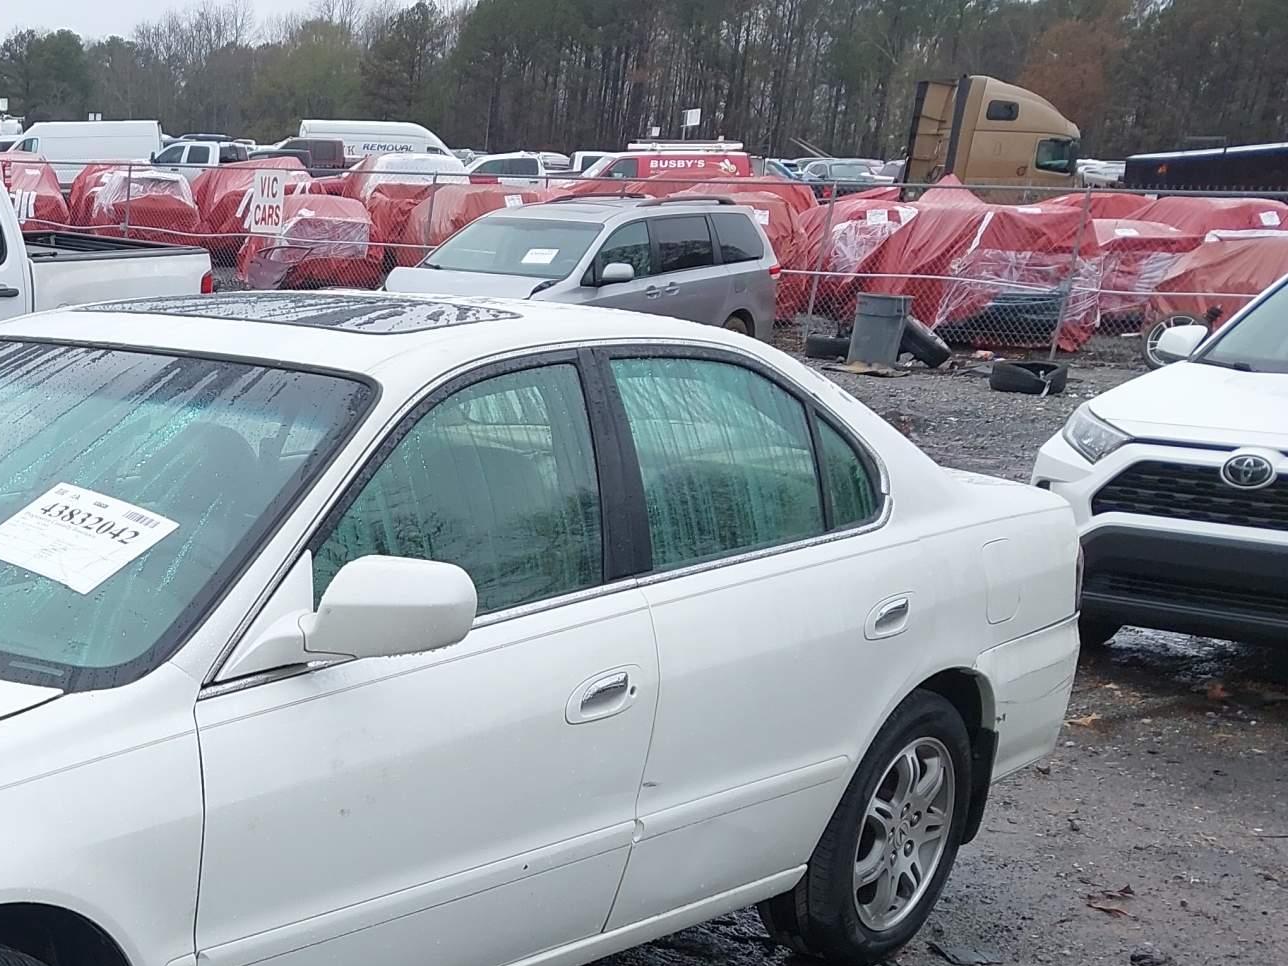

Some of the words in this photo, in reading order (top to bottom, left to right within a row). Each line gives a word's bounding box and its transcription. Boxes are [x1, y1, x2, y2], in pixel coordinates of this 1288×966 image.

[362, 143, 415, 152] REMOVAL
[650, 159, 705, 168] BUSBY'S
[260, 175, 279, 198] VIC
[253, 203, 281, 226] CARS
[40, 502, 140, 544] 43832042
